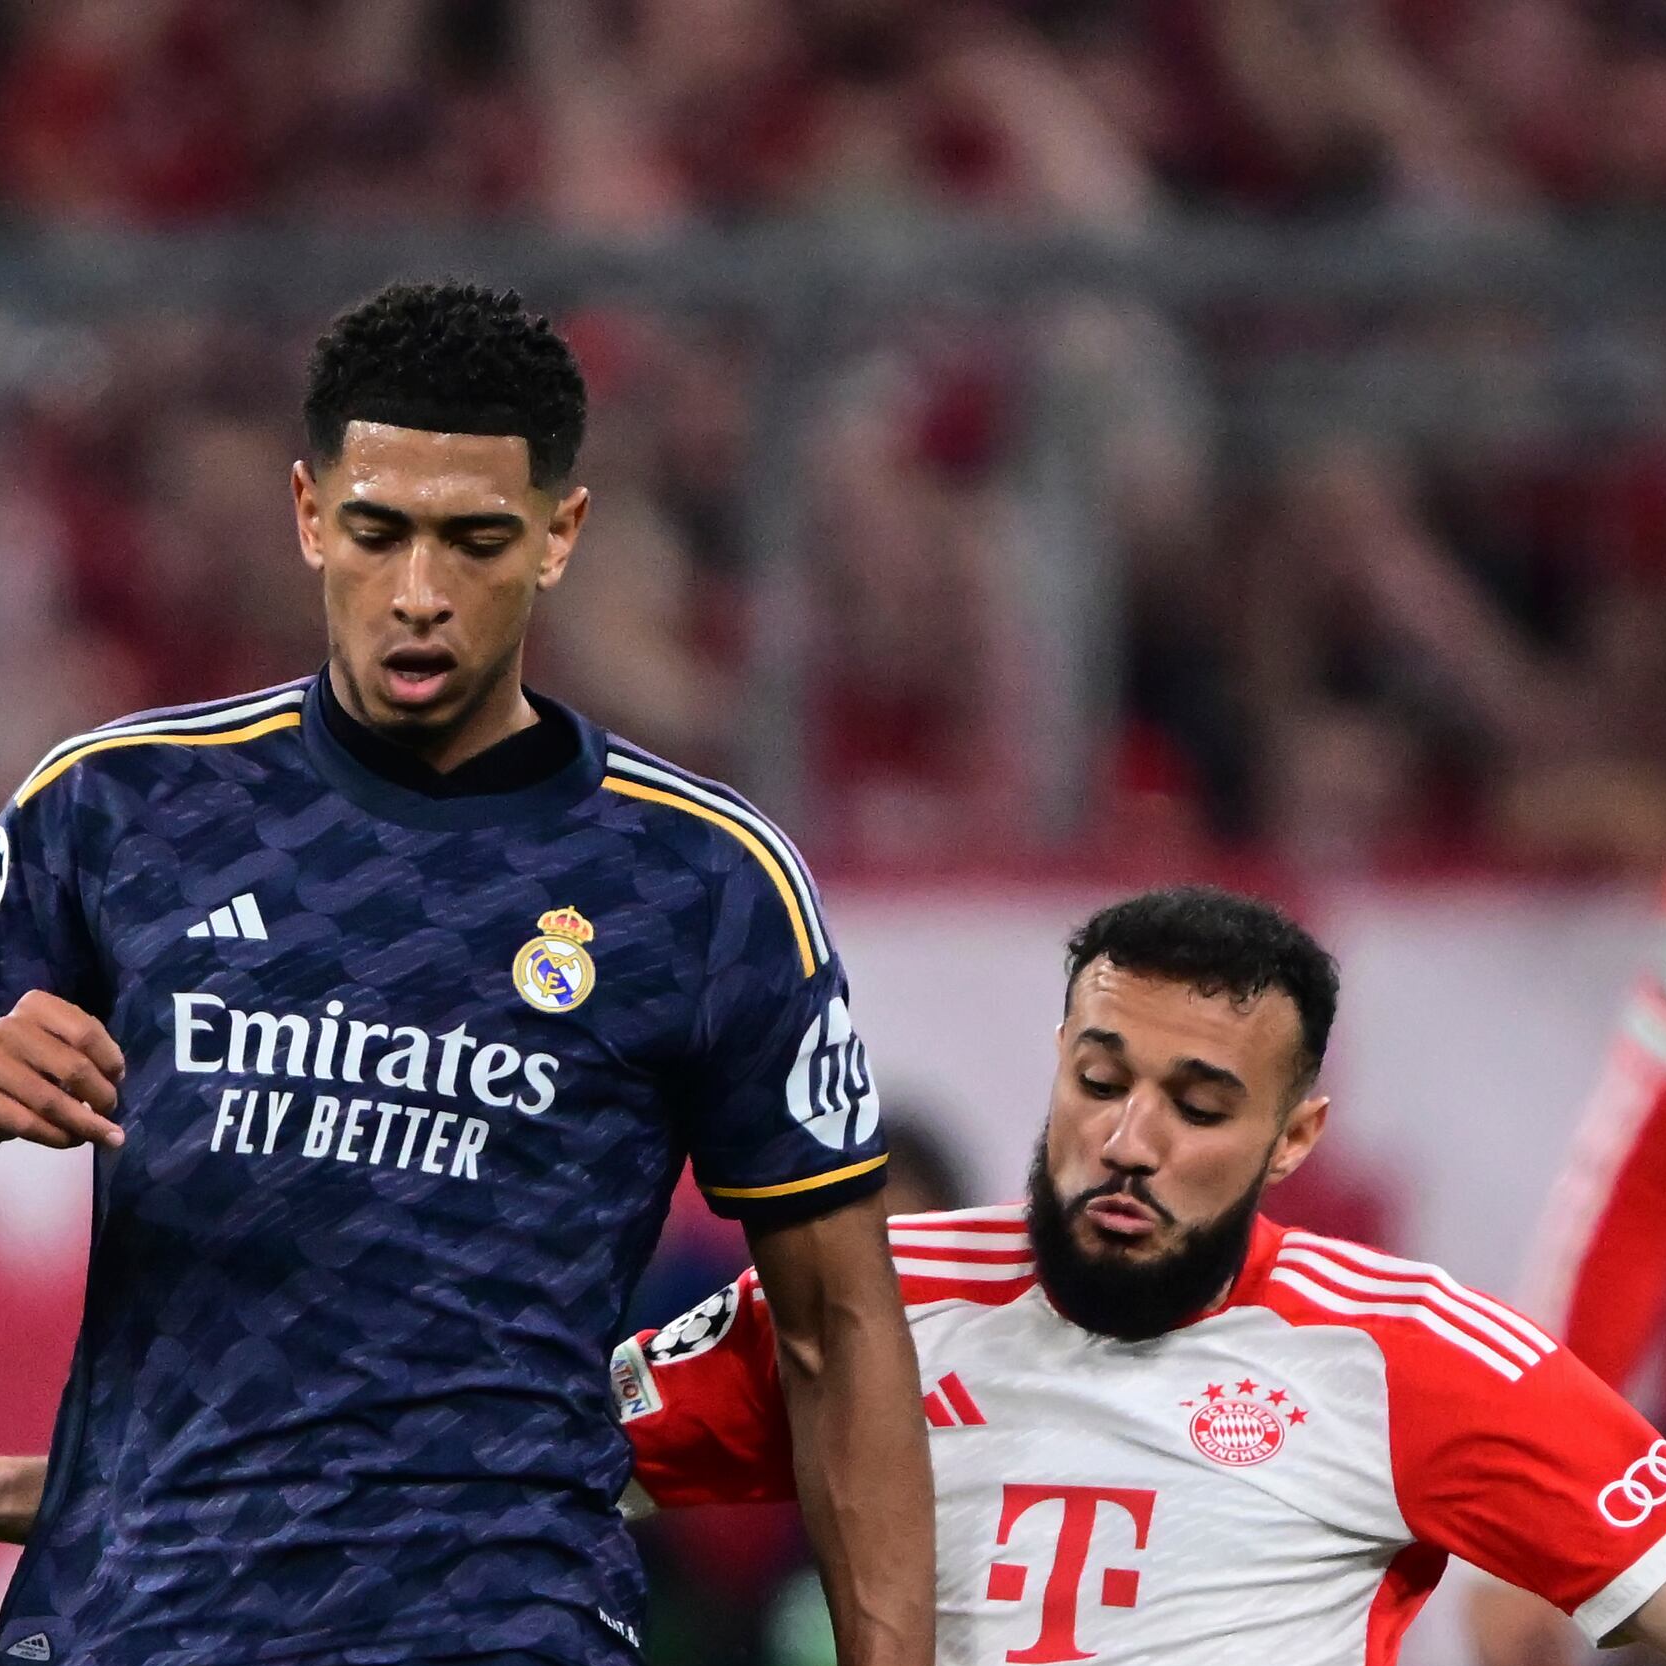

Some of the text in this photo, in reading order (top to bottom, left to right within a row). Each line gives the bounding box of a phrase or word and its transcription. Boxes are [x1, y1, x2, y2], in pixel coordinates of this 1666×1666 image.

[172, 992, 560, 1115] Emirates
[210, 1089, 490, 1180] FLY BETTER
[986, 1483, 1157, 1664] T
